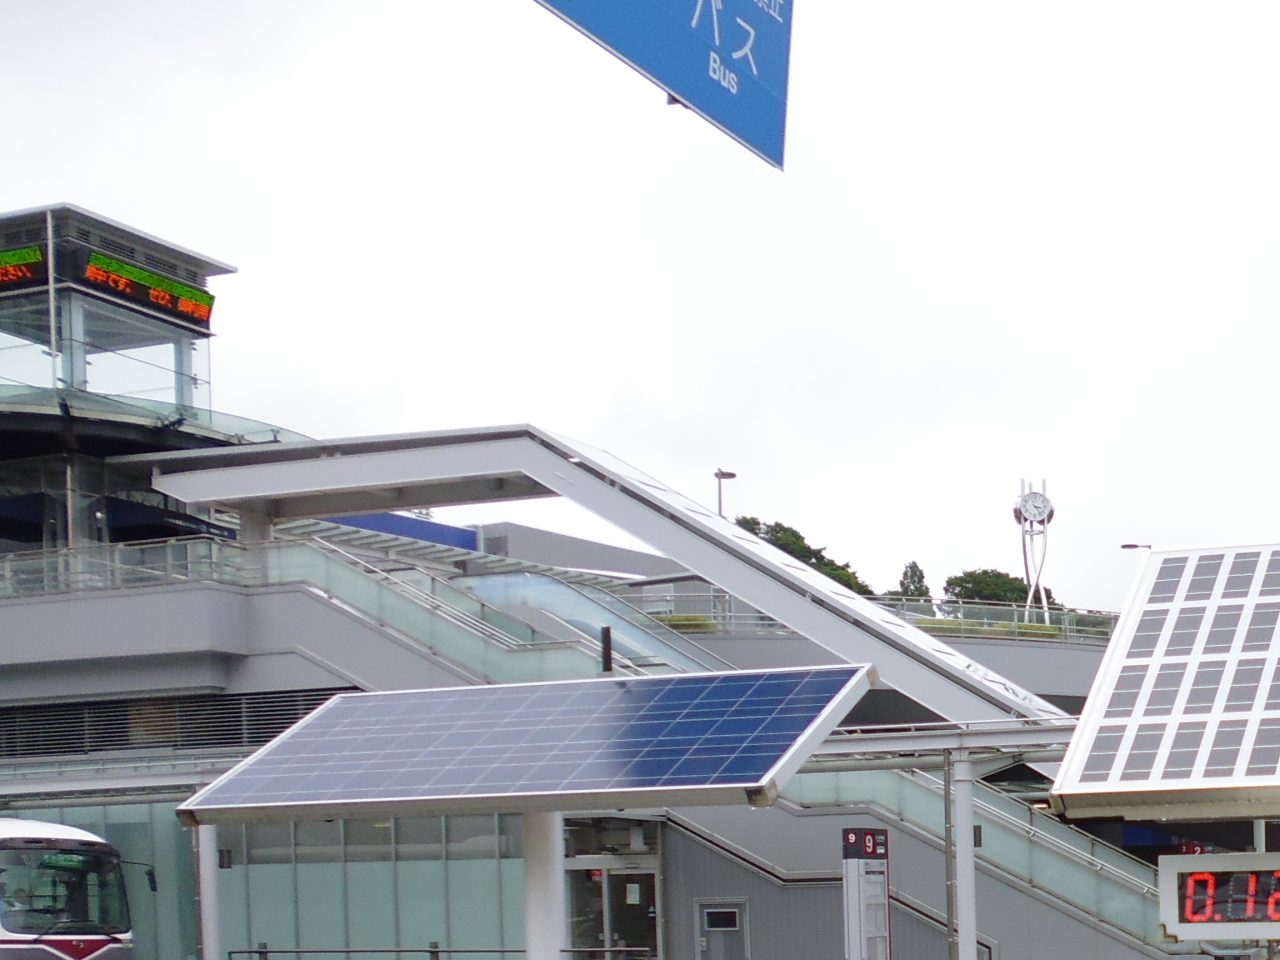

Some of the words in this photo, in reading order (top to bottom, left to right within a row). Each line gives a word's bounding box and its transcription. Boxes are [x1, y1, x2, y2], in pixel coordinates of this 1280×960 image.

[709, 51, 738, 94] Bus
[848, 833, 856, 843] 9
[865, 834, 873, 853] 9
